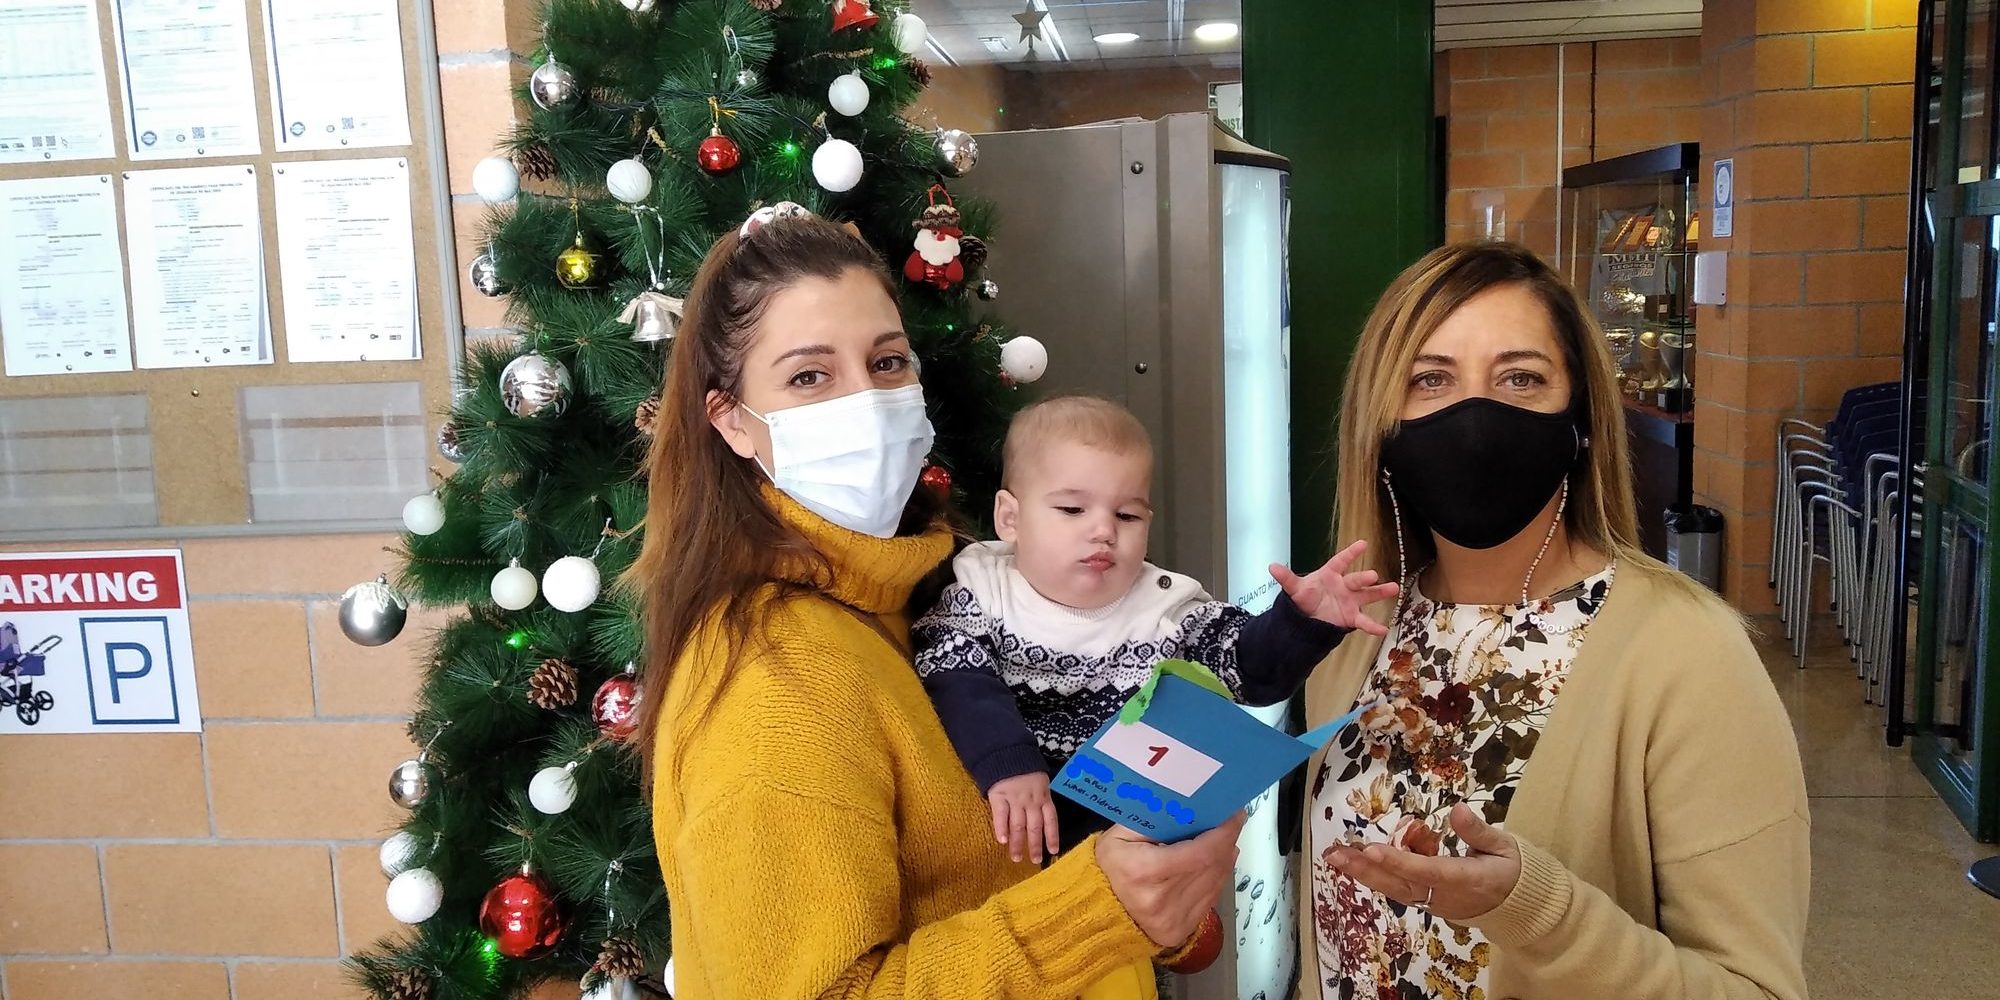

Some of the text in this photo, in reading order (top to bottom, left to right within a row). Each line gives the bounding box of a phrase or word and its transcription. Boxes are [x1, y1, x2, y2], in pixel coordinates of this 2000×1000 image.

[1238, 584, 1267, 607] CUANTO
[104, 642, 153, 704] P
[1148, 745, 1169, 767] 1
